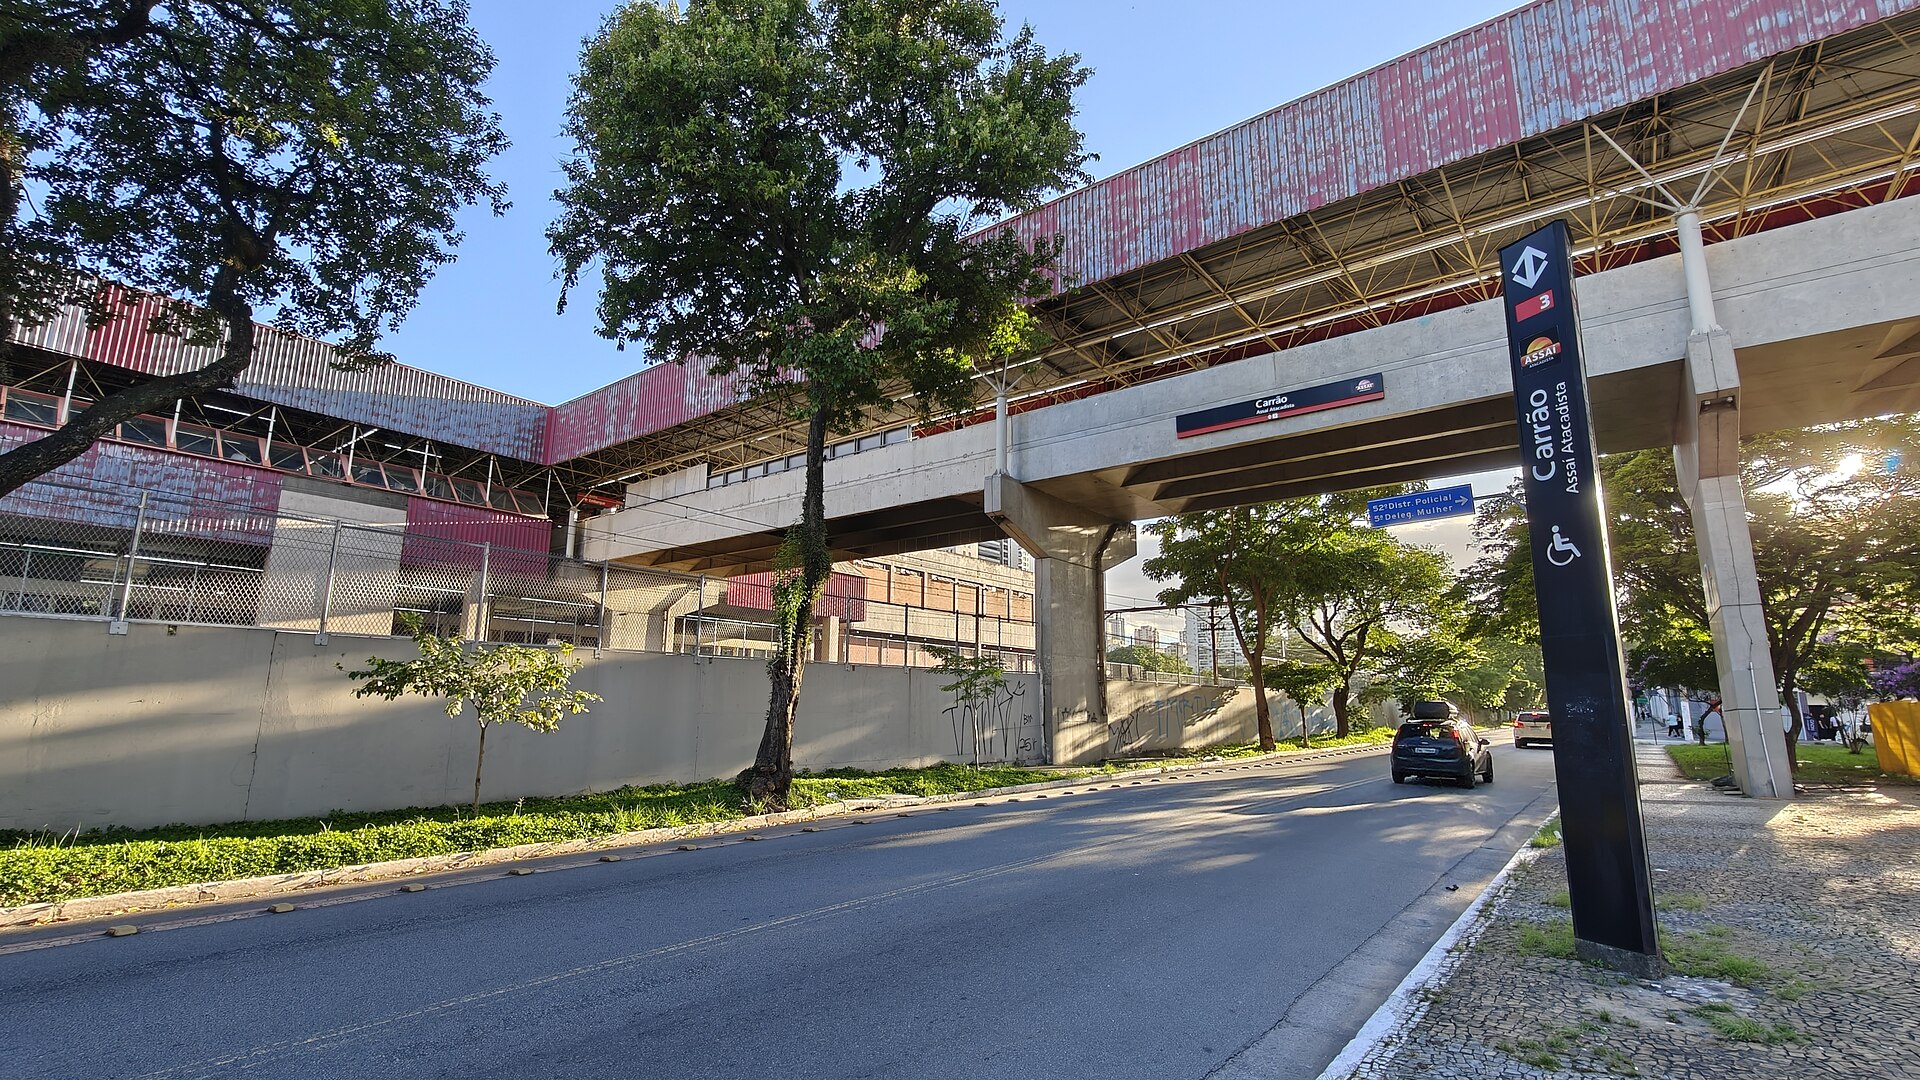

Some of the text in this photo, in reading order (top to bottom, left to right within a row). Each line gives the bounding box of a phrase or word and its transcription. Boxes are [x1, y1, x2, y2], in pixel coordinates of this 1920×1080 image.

[1539, 294, 1551, 310] 3
[1255, 395, 1288, 408] Carrão
[1525, 389, 1556, 481] Carrão
[1555, 381, 1580, 494] Assaí Atacadista
[1415, 493, 1452, 506] Policial
[1417, 505, 1453, 516] Mulher
